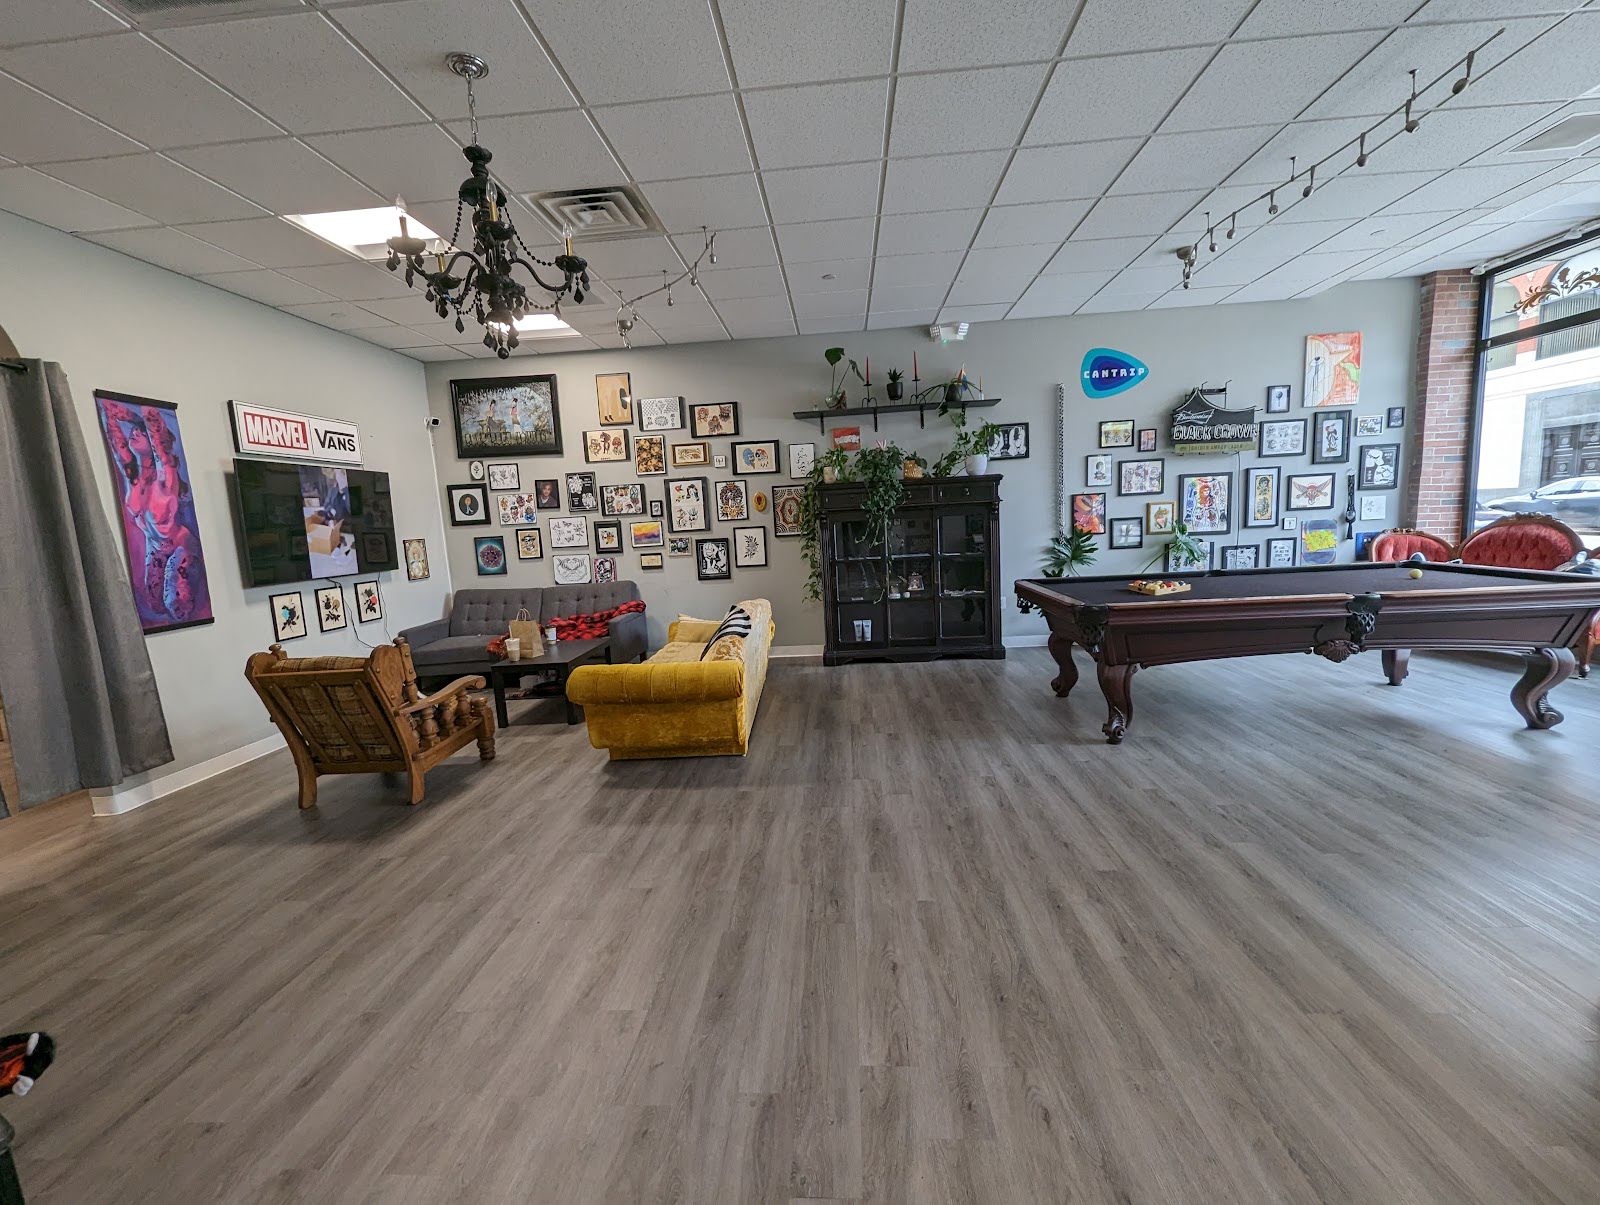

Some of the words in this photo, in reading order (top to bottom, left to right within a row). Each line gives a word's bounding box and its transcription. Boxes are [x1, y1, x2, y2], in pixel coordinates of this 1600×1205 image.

[1083, 367, 1145, 379] CANTRIP
[245, 414, 308, 449] MARVEL
[314, 428, 356, 452] VANS
[1173, 424, 1211, 441] BLACK
[1213, 423, 1260, 439] CROWN
